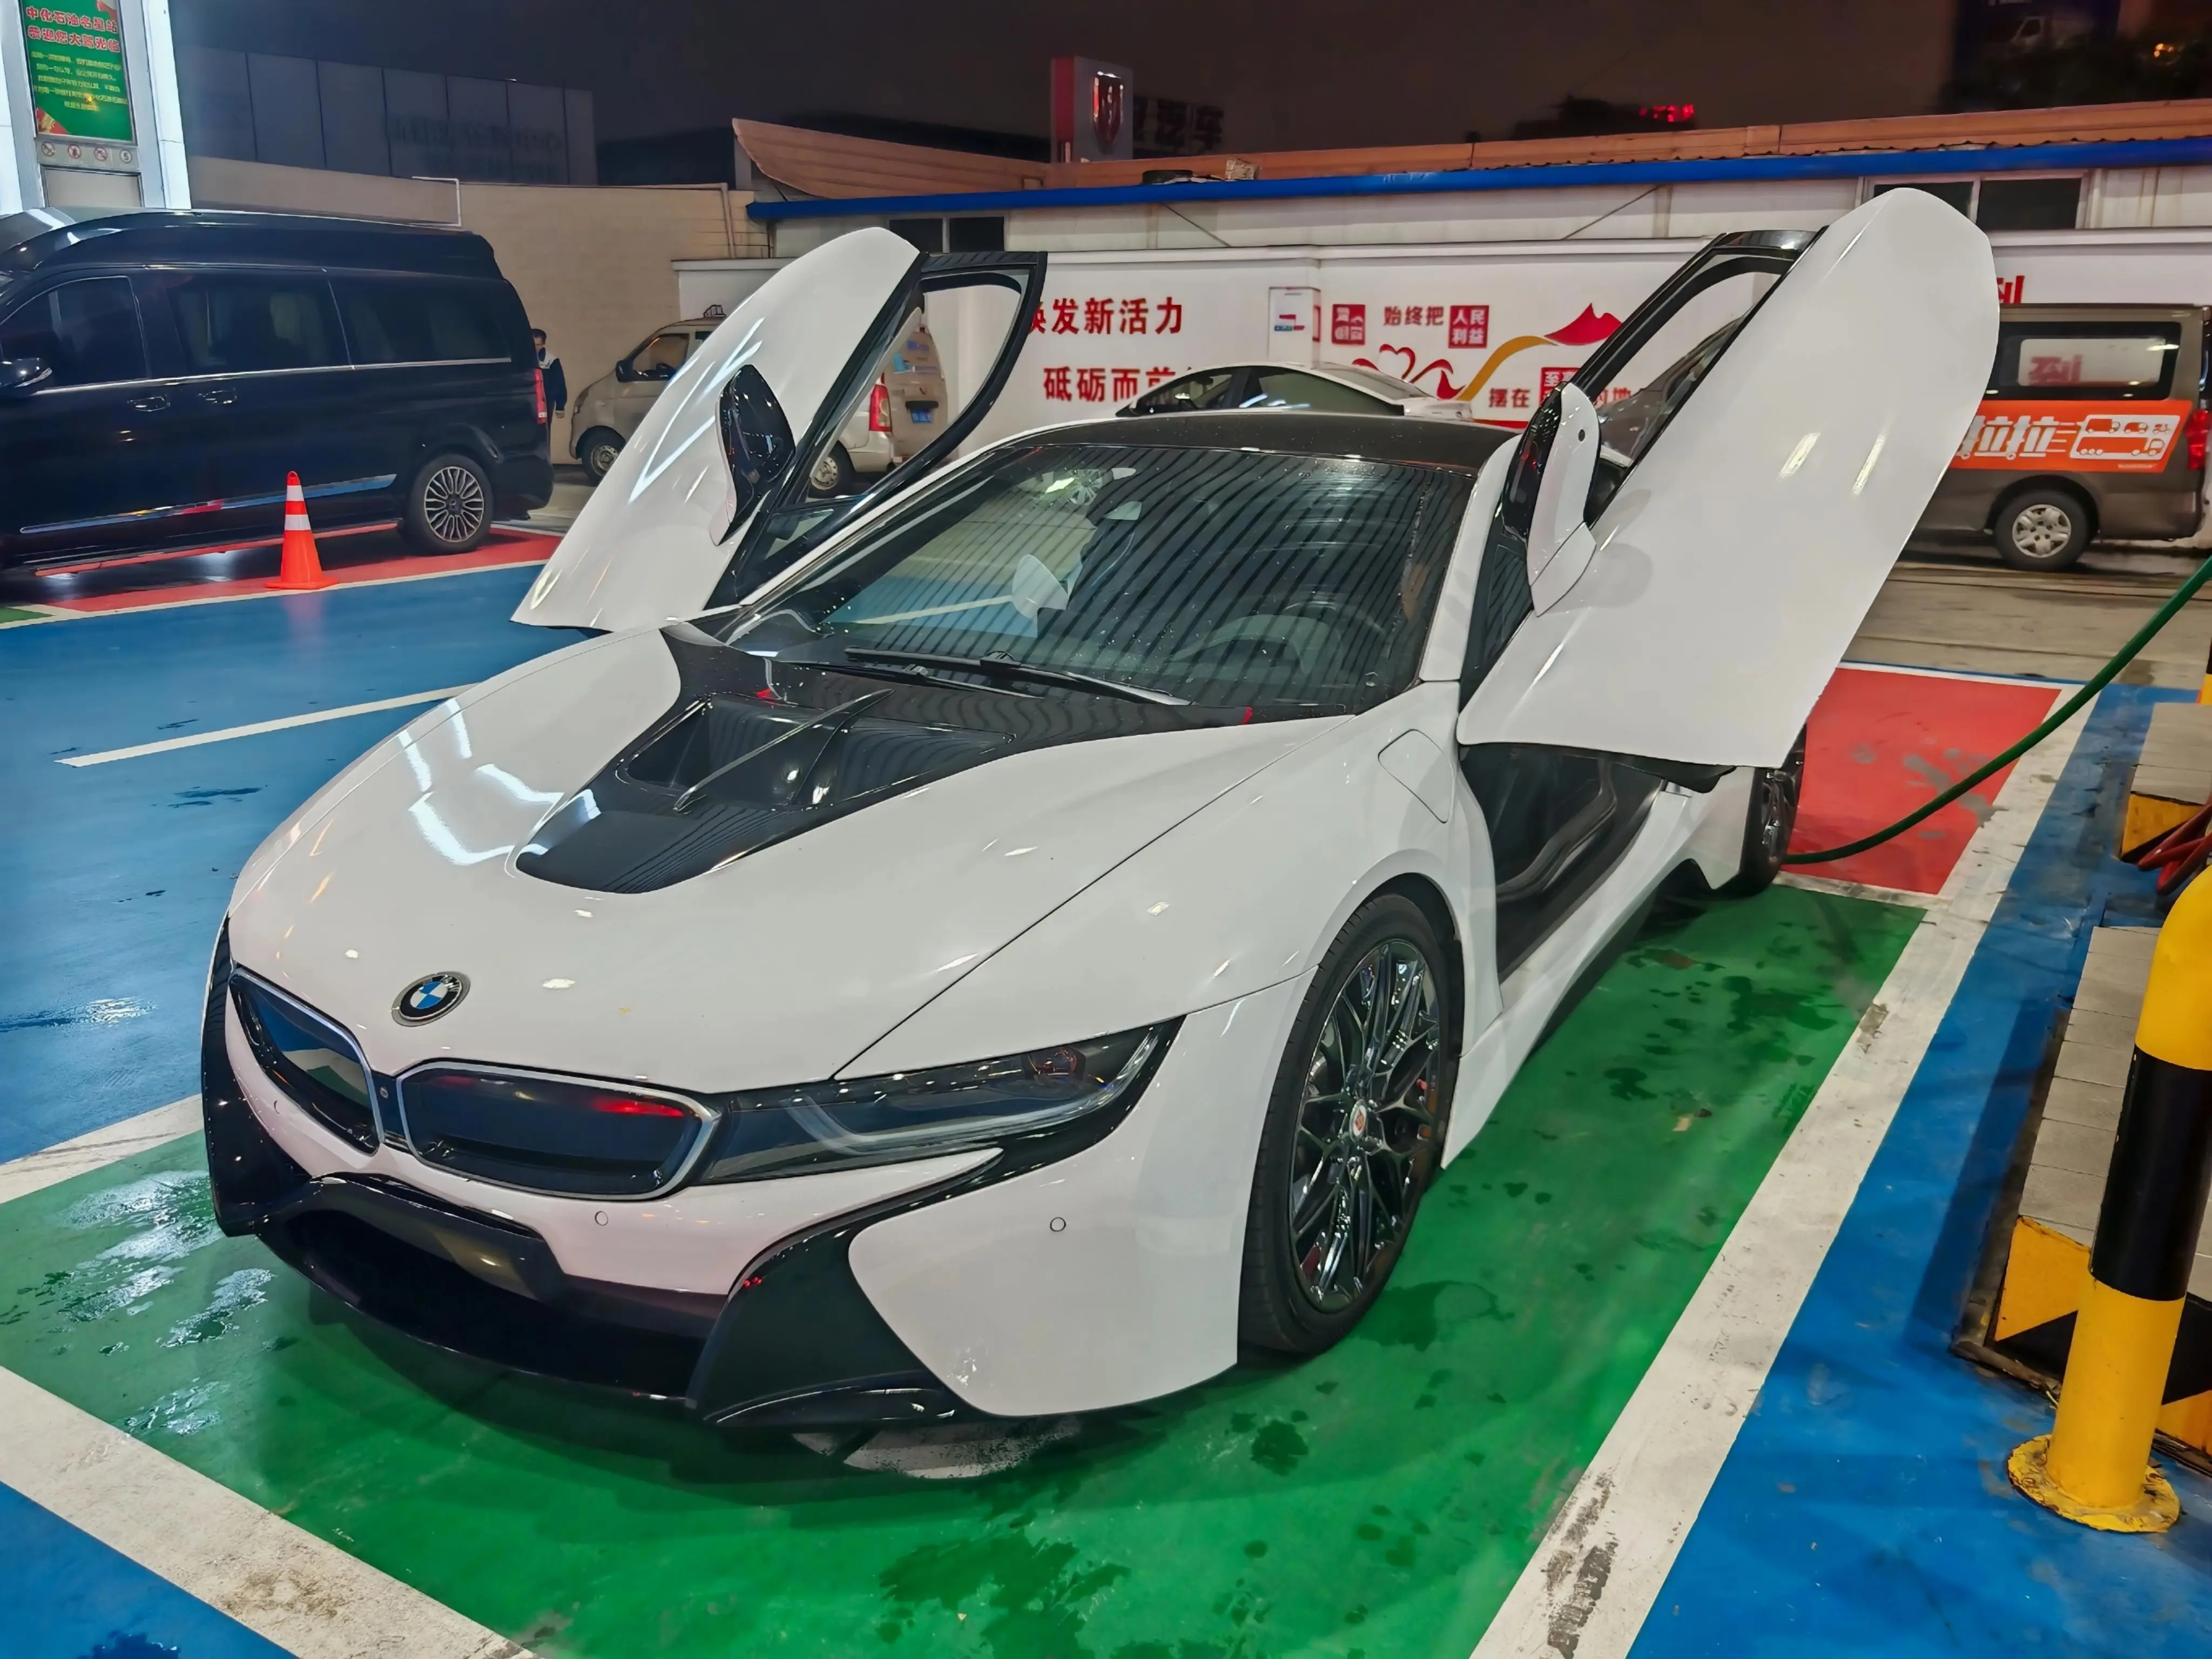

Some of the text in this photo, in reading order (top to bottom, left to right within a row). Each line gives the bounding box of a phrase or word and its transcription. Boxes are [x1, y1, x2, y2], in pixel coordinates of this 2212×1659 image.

[28, 25, 120, 52] 恭迎您大驾光临
[1383, 306, 1444, 326] 始终把
[1453, 309, 1486, 325] 人民
[1452, 328, 1485, 345] 利益
[1489, 388, 1530, 408] 摆在
